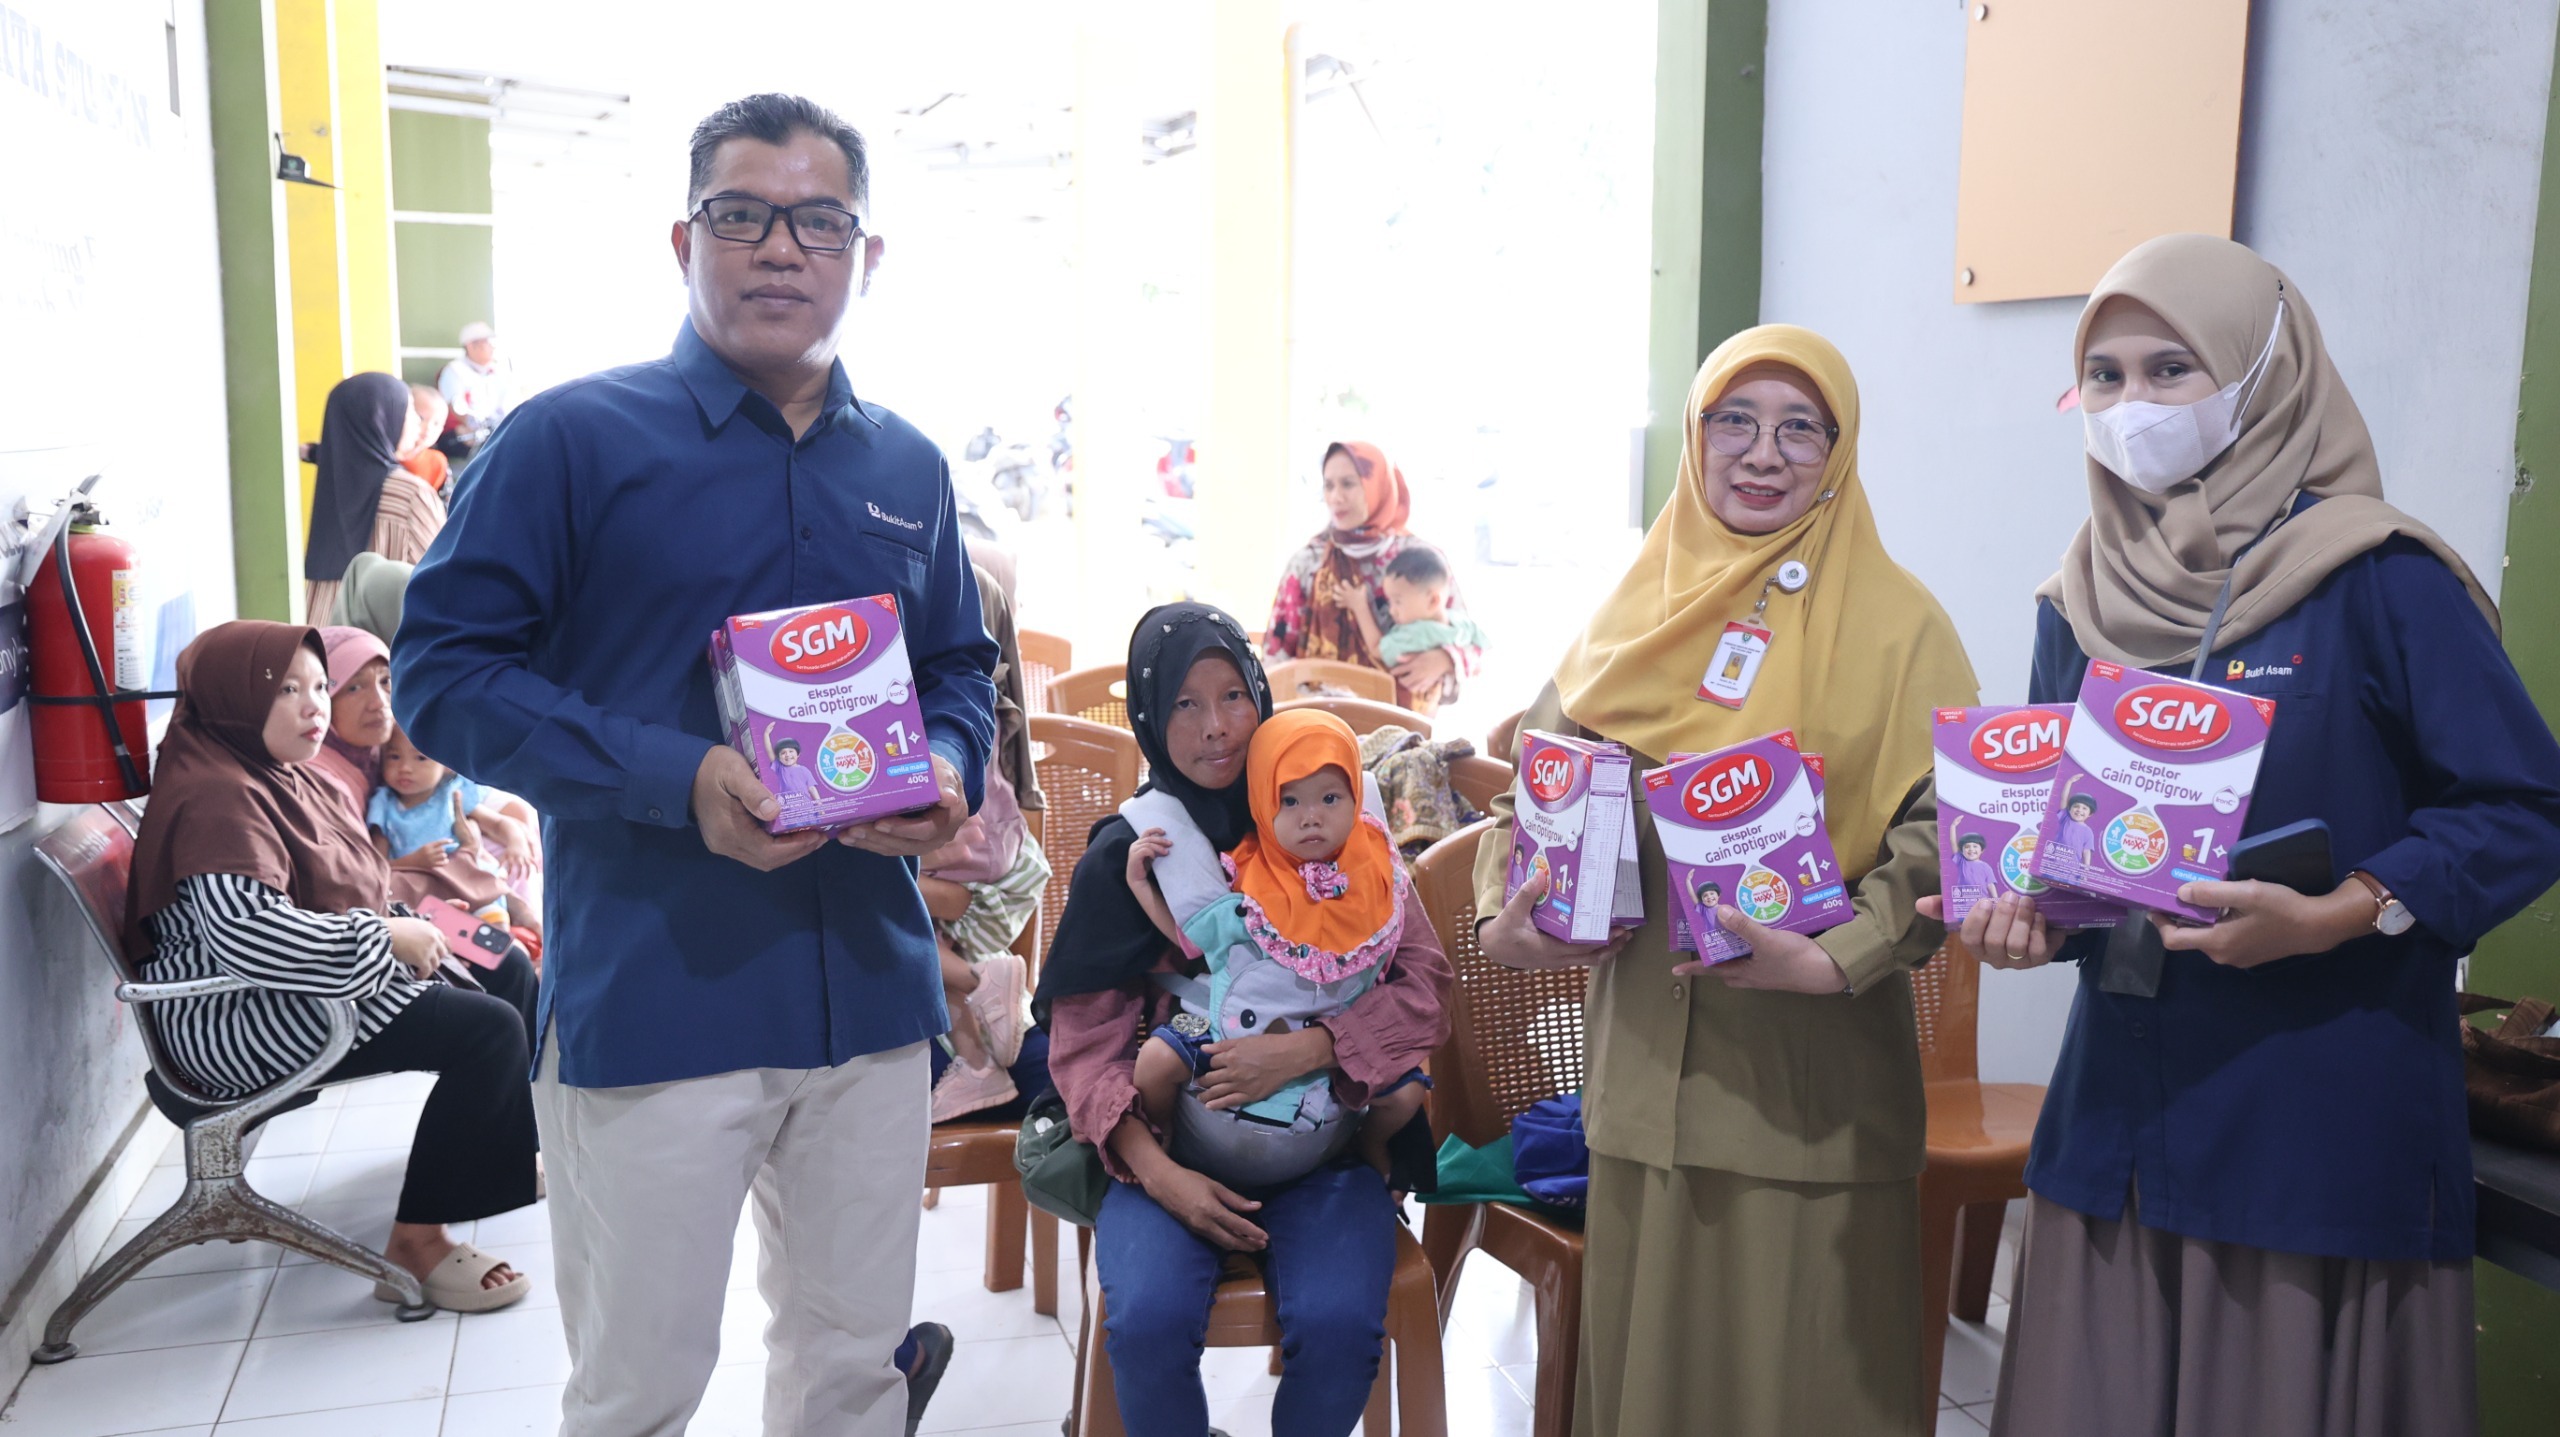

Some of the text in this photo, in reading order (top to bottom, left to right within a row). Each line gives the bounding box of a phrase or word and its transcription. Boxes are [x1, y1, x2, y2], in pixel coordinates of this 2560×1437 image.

[781, 615, 857, 663] SGM
[2266, 665, 2293, 676] Asam
[808, 684, 853, 700] Eksplor
[788, 694, 878, 718] Gain Optigrow
[2125, 696, 2218, 735] SGM
[1982, 718, 2061, 760] SGM
[907, 774, 929, 785] 400g
[1532, 758, 1570, 787] SGM
[2129, 760, 2181, 780] Eksplor
[1692, 758, 1762, 814] SGM
[2002, 788, 2050, 799] Eksplor
[2101, 767, 2203, 802] Gain Optigrow
[1979, 801, 2008, 814] Gain
[1534, 812, 1555, 826] Eksplor
[1524, 819, 1536, 832] Gain
[1536, 824, 1564, 844] Optigrow
[1721, 824, 1762, 844] Eksplor
[1705, 829, 1788, 864] Gain Optigrow
[1822, 899, 1844, 910] 400g
